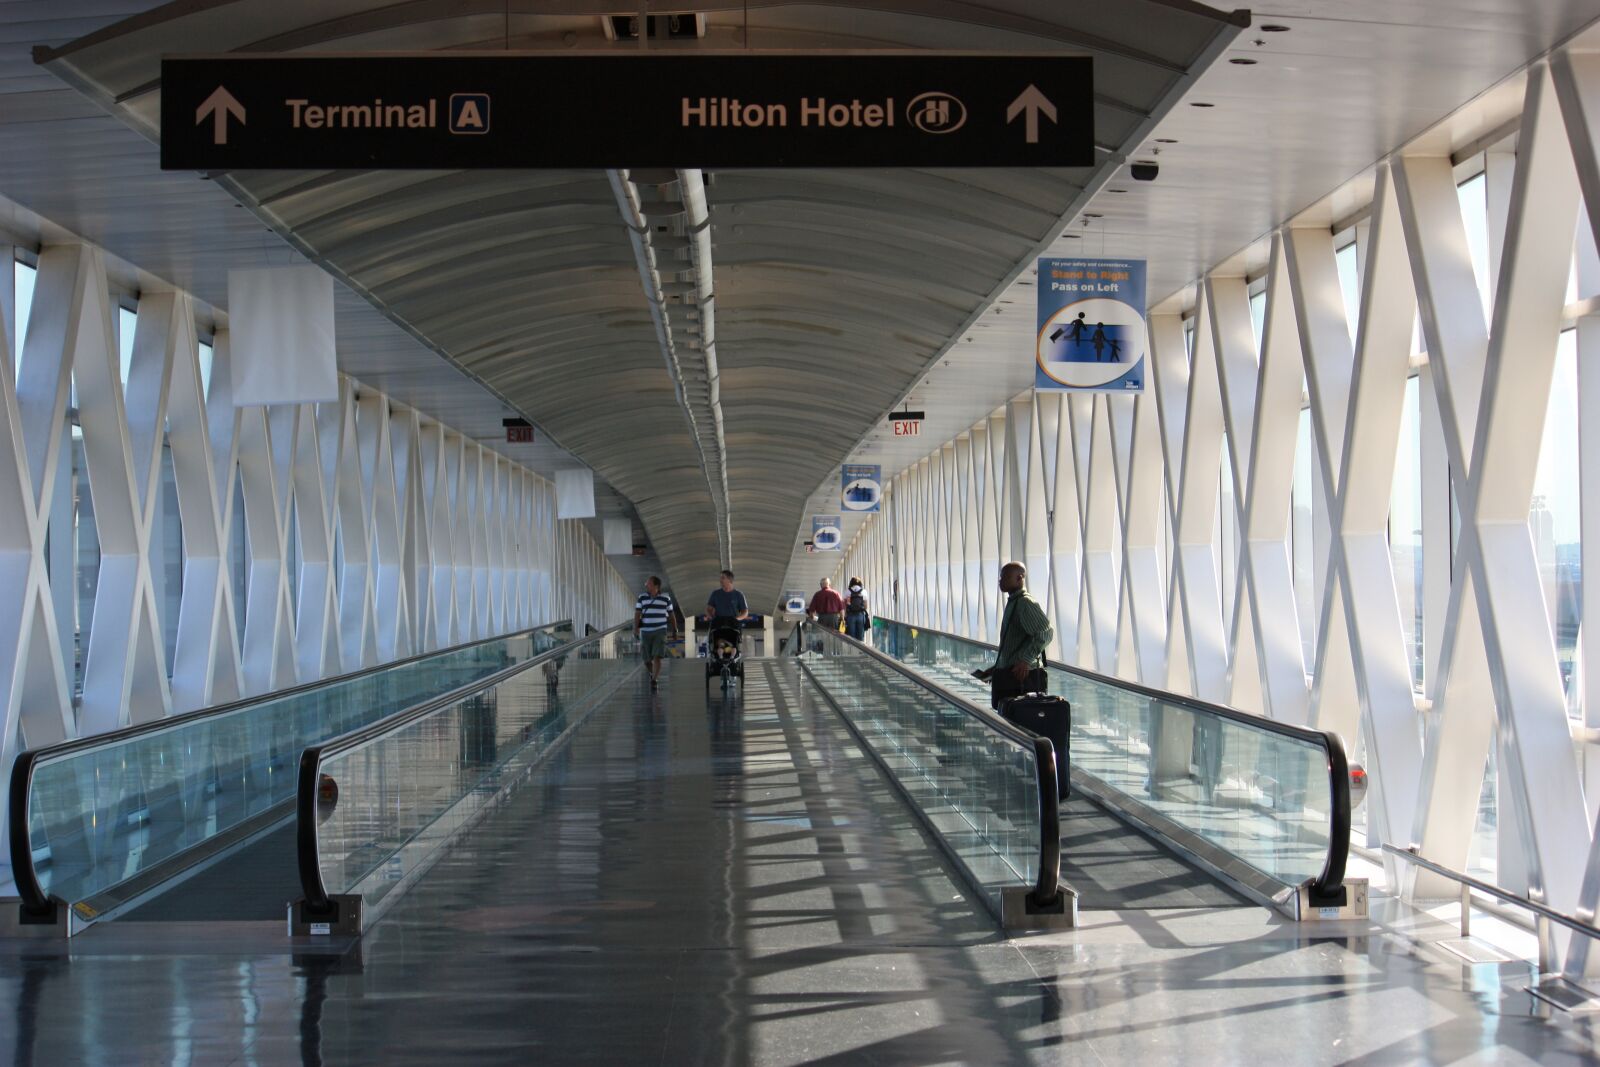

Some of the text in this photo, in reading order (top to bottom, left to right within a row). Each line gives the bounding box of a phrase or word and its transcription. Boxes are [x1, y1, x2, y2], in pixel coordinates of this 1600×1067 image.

[285, 98, 483, 128] Terminal A
[681, 97, 787, 127] Hilton
[800, 97, 895, 127] Hotel
[1051, 270, 1129, 281] Stand to Right
[1051, 282, 1120, 292] Pass on Left
[507, 427, 534, 442] EXIT
[894, 421, 920, 436] EXIT
